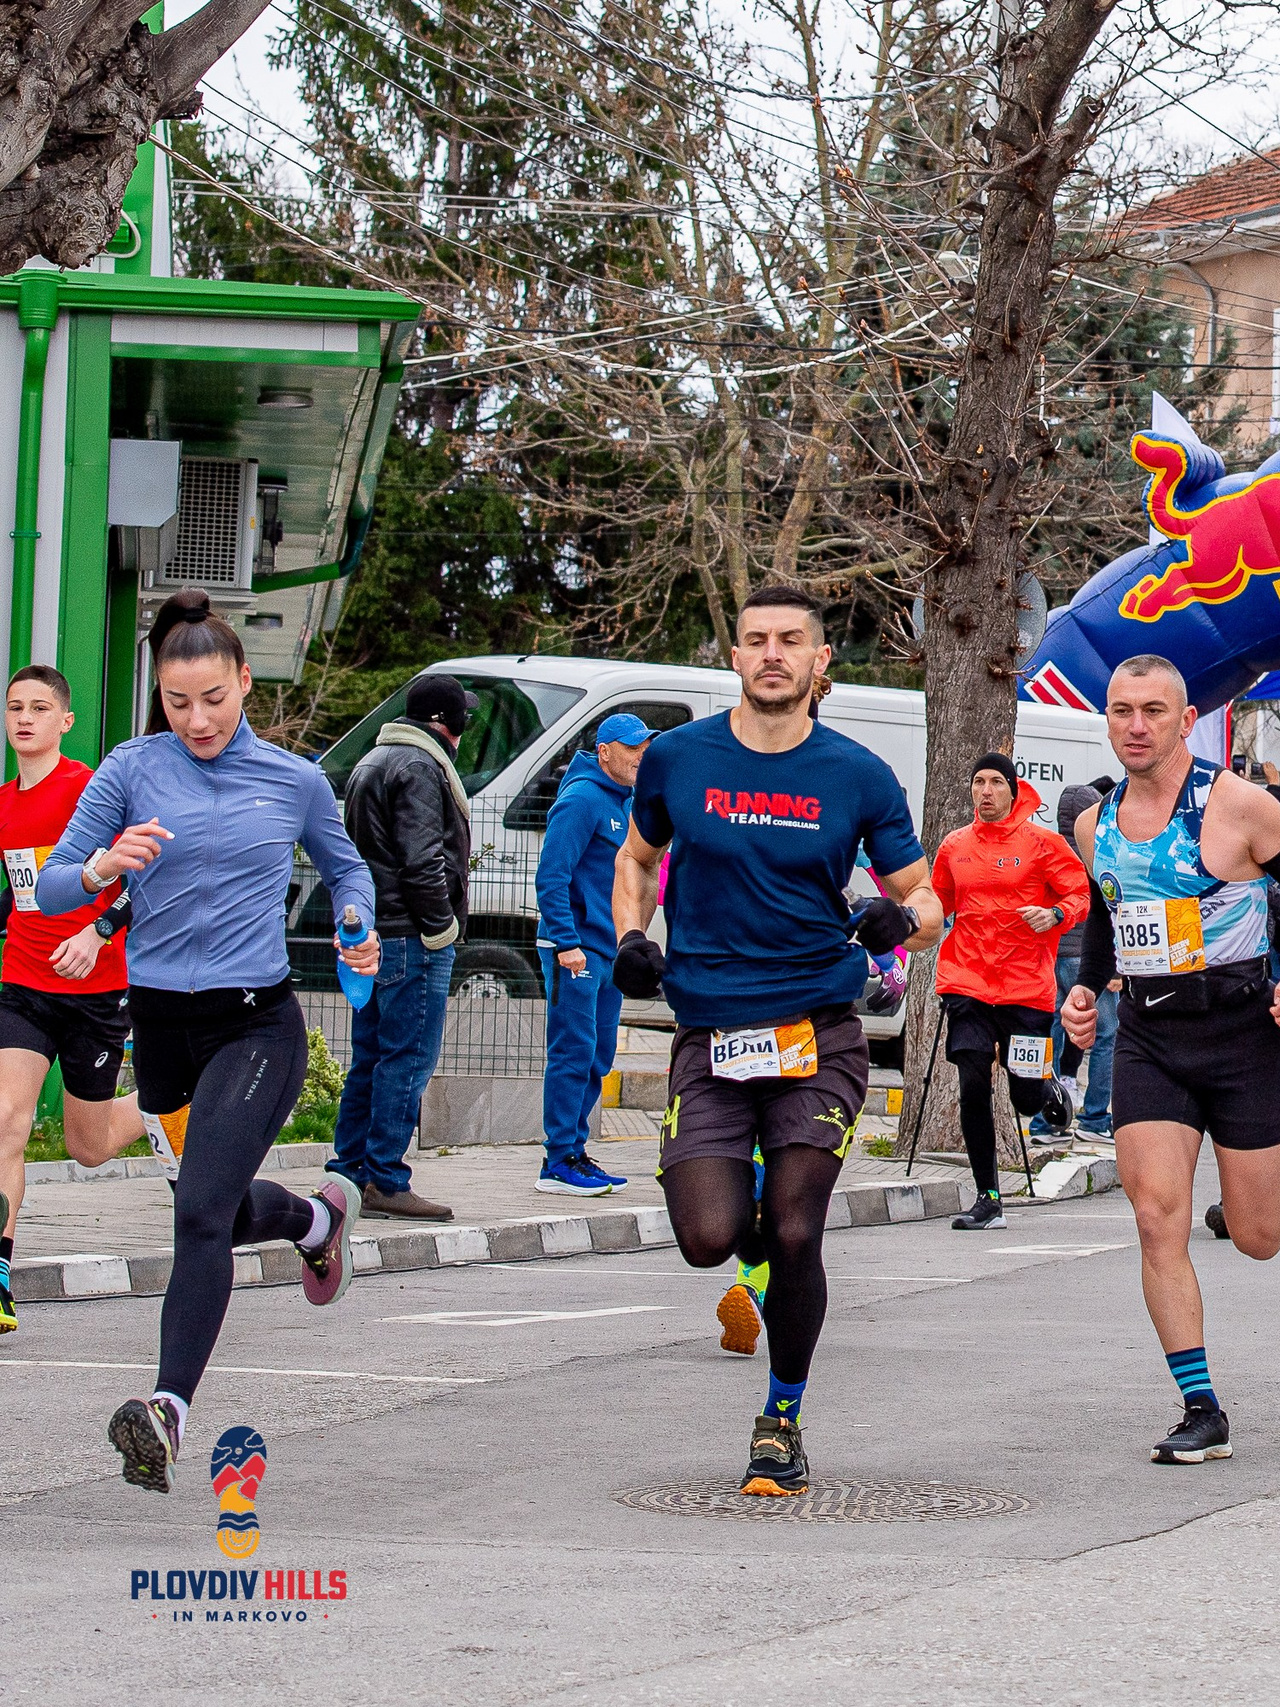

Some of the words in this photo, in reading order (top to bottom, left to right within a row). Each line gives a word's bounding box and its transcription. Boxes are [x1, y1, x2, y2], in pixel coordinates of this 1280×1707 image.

[705, 787, 822, 820] RUNNING
[728, 813, 772, 825] TEAM
[772, 819, 820, 830] CONEGLIANO
[1118, 922, 1161, 948] 1385
[713, 1038, 774, 1064] ВЕЛИ
[1013, 1047, 1040, 1062] 1361
[255, 1058, 269, 1079] NIKE
[244, 1079, 260, 1101] TRAIL
